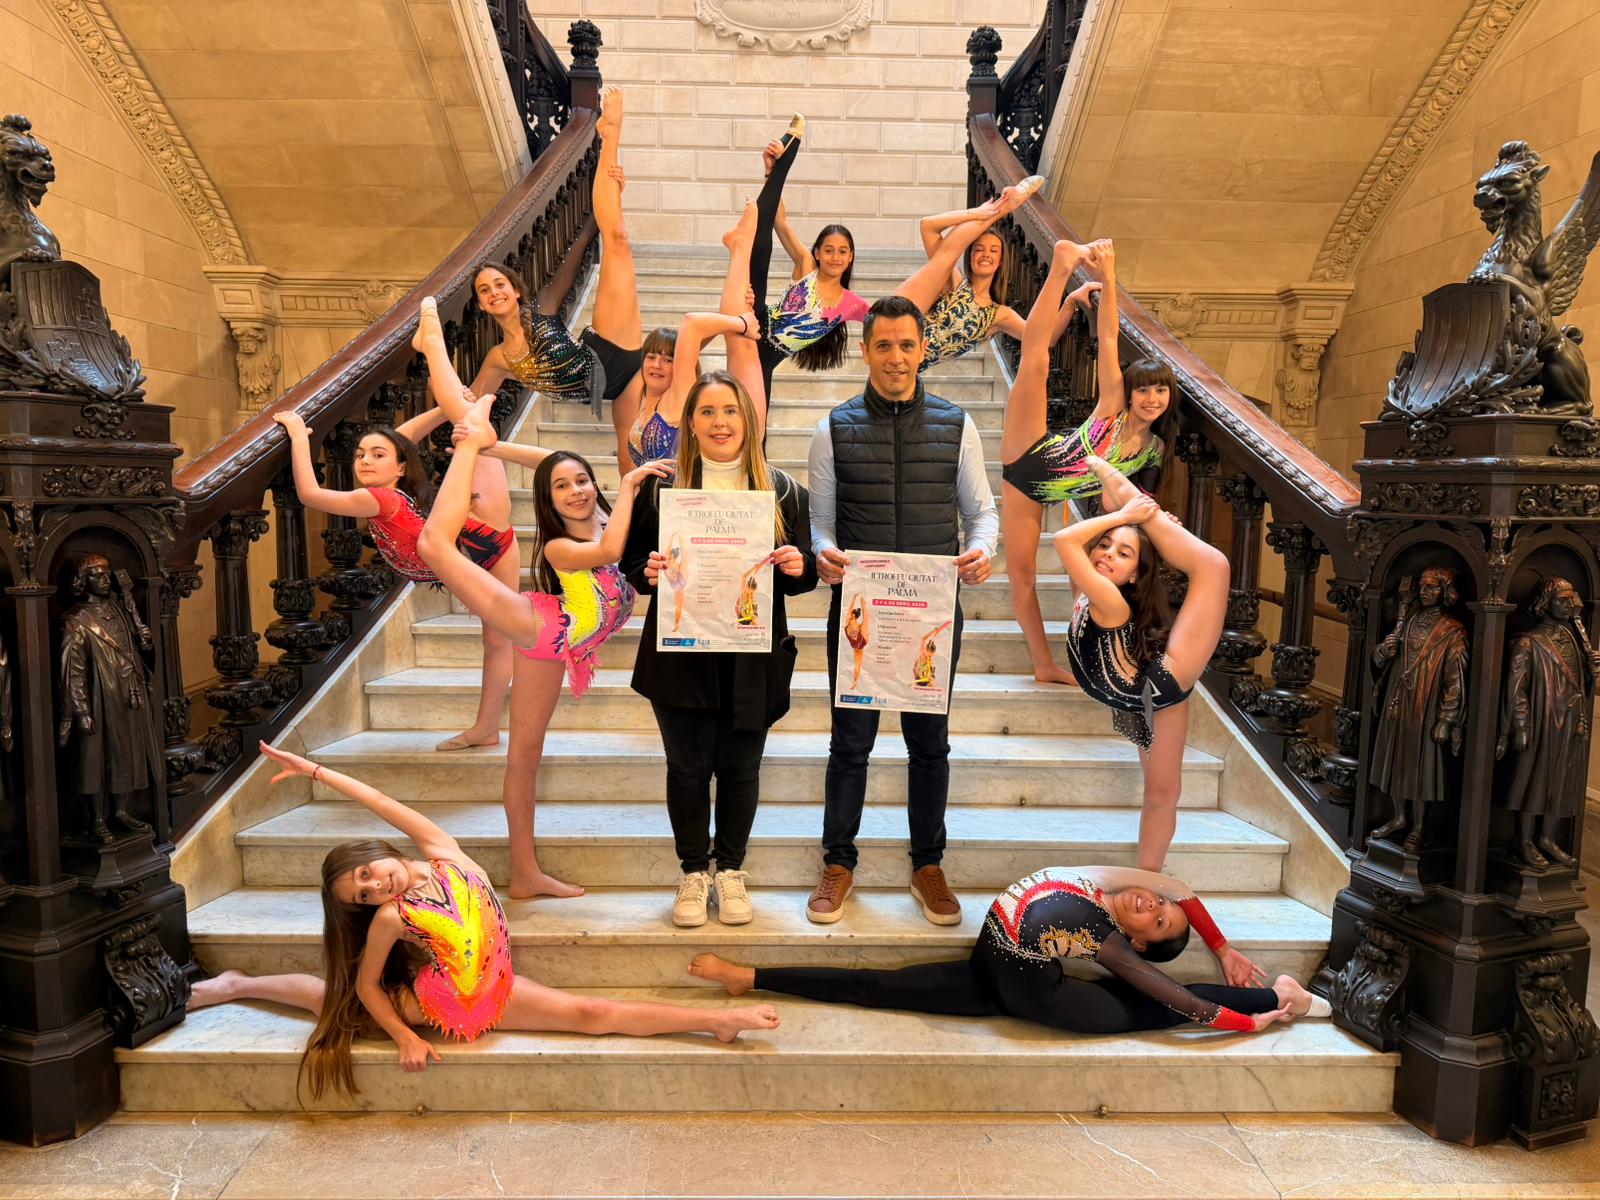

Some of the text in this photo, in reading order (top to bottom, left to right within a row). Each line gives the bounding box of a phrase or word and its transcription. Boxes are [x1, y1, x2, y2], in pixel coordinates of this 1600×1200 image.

[726, 510, 753, 519] CIUTAT
[714, 518, 725, 526] DE
[705, 525, 736, 534] PALMA
[878, 572, 907, 581] TROFEU
[908, 574, 938, 582] CIUTAT
[888, 588, 918, 597] PALMA
